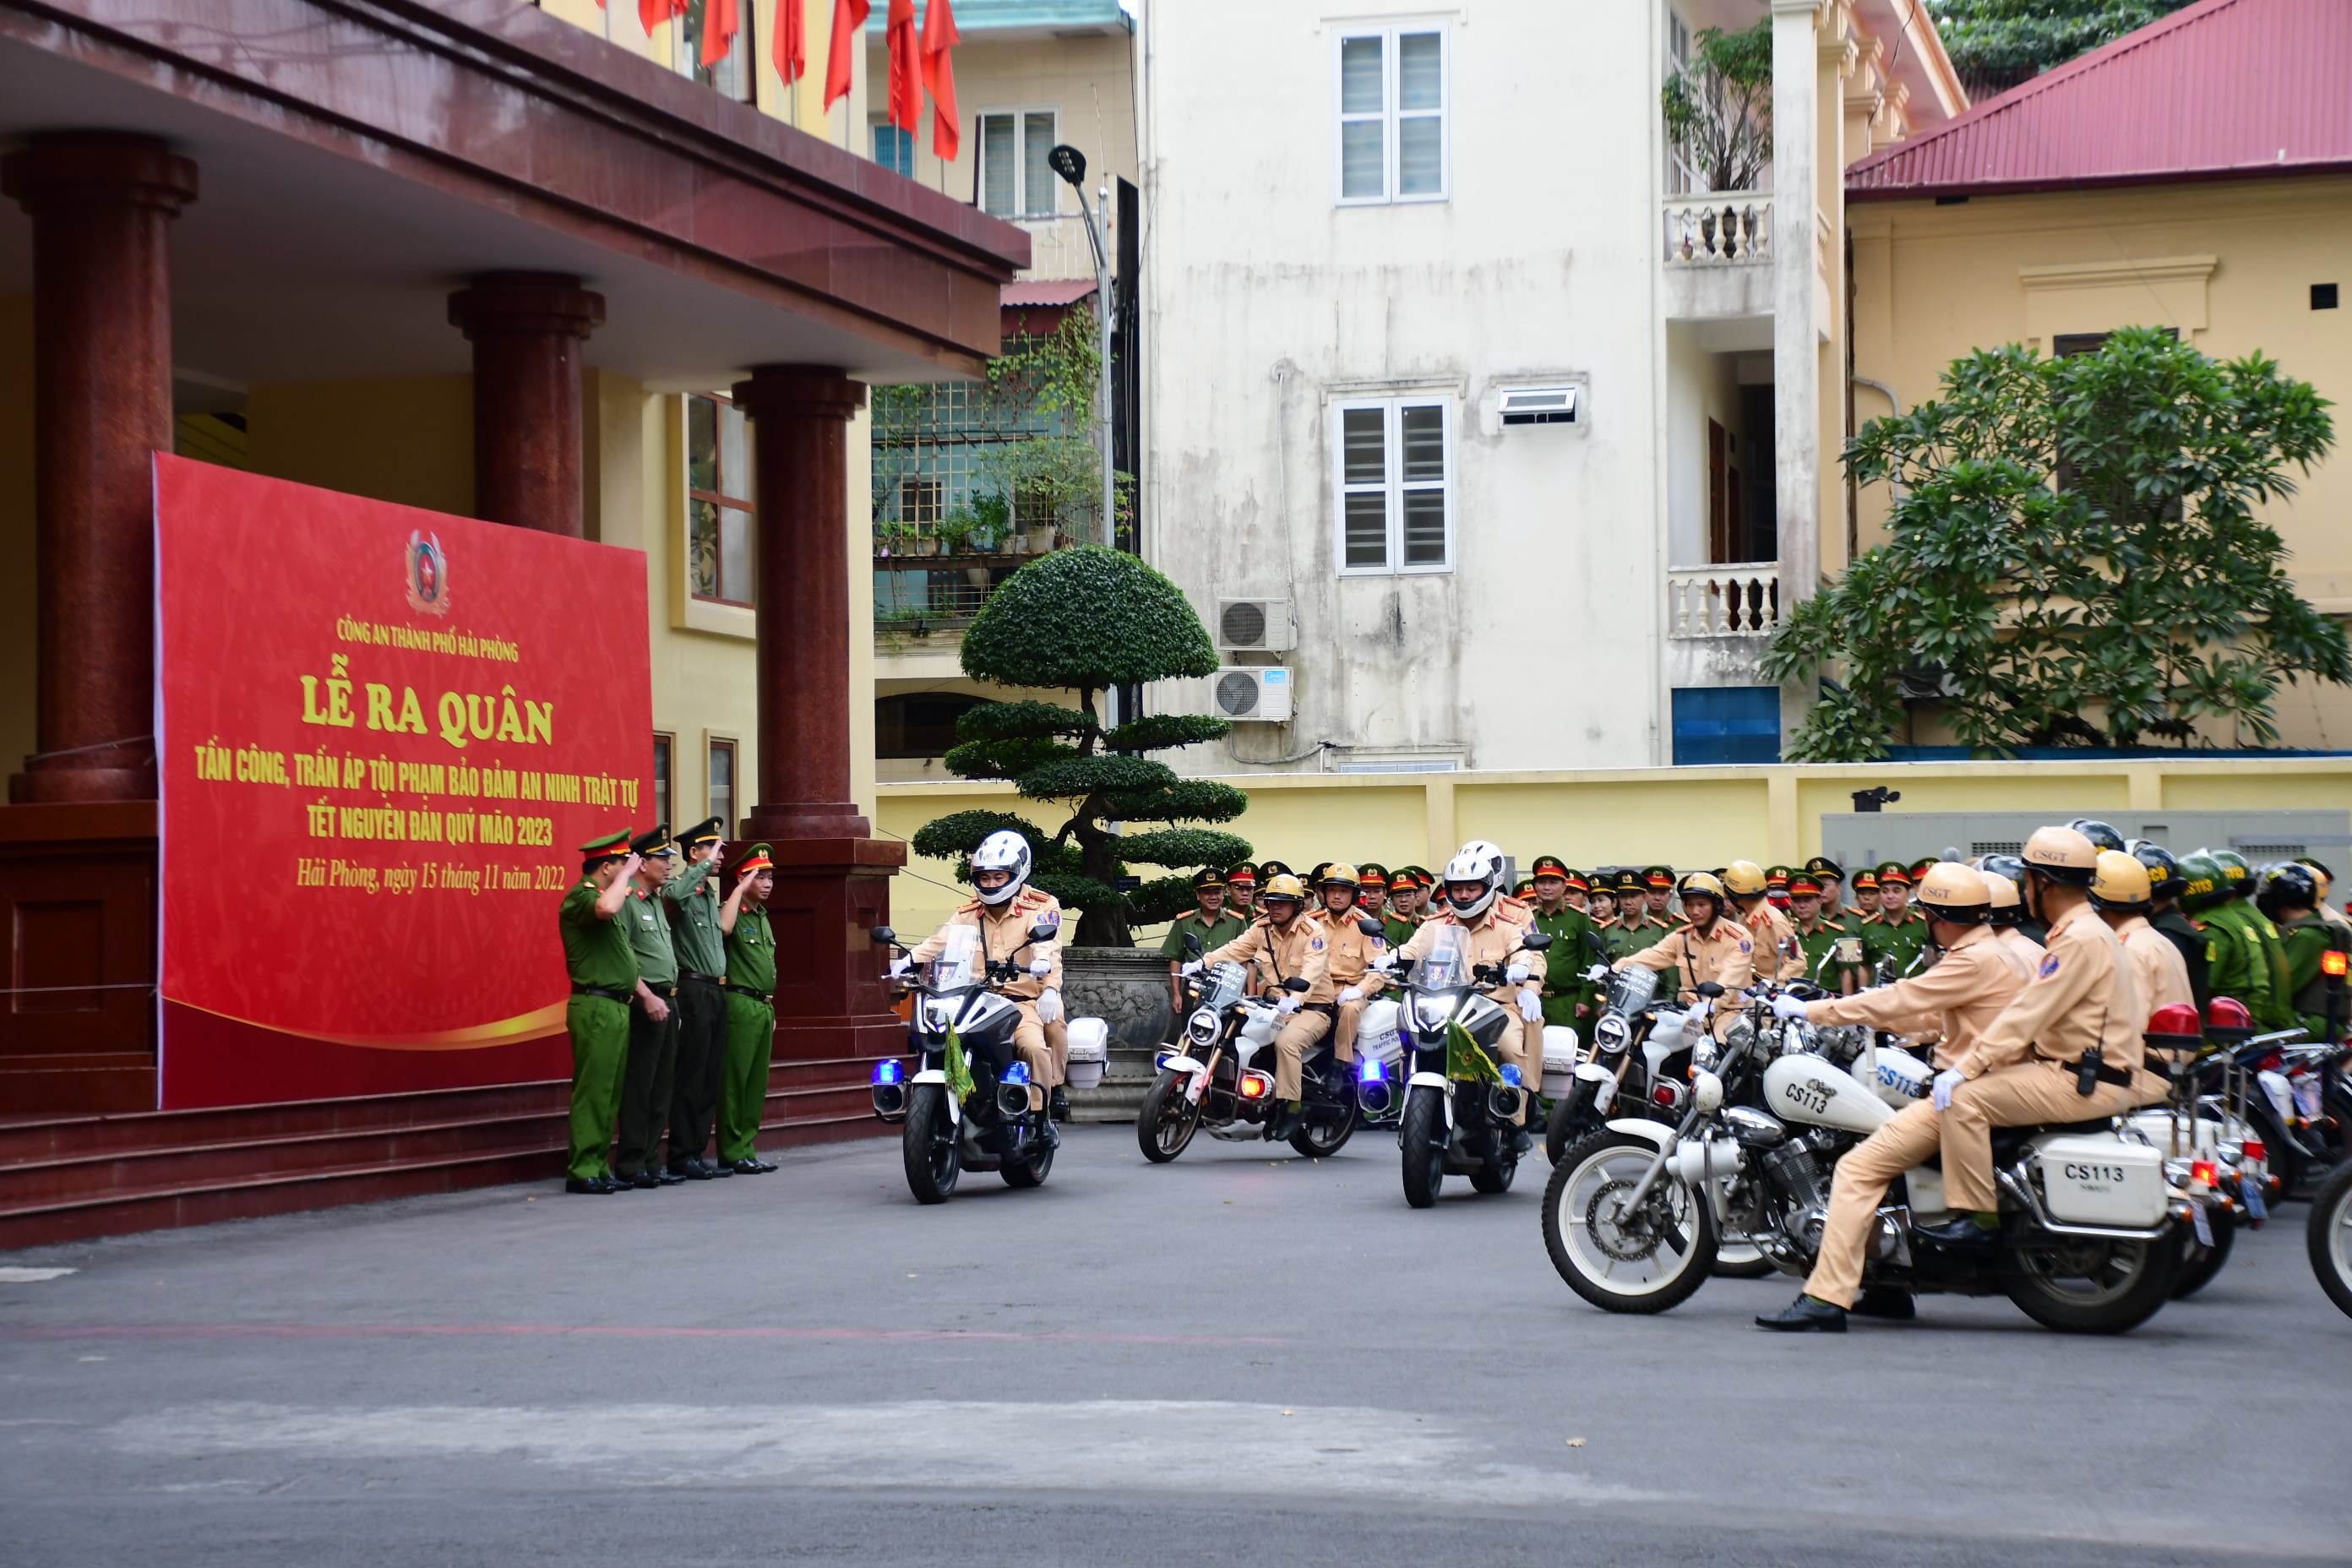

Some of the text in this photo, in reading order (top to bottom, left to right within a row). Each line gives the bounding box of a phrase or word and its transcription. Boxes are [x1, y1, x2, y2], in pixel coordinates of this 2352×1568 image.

[337, 613, 519, 662] CÔNG AN THÀNH PHỐ HẢI PHÒNG
[300, 653, 553, 749] LỄ RA QUÂN
[194, 734, 639, 814] TẤN CÔNG, TRẤN ÁP TỘI PHẠM BẢO ĐẢM AN NINH TRẬT TỰ
[307, 795, 553, 846] TẾT NGUYÊN ĐÁN QUÝ MÃO 2023
[2033, 850, 2068, 863] CSGT
[297, 858, 565, 896] Hải Phòng, ngày 15 tháng 11 năm 2022
[1923, 886, 1952, 900] CSGT
[1206, 976, 1238, 990] POLICE
[1211, 969, 1242, 983] TRAFFIC
[1214, 962, 1246, 976] CSGT
[1877, 1065, 1920, 1098] CS113
[1786, 1083, 1827, 1114] CS113
[2065, 1163, 2124, 1182] CS113
